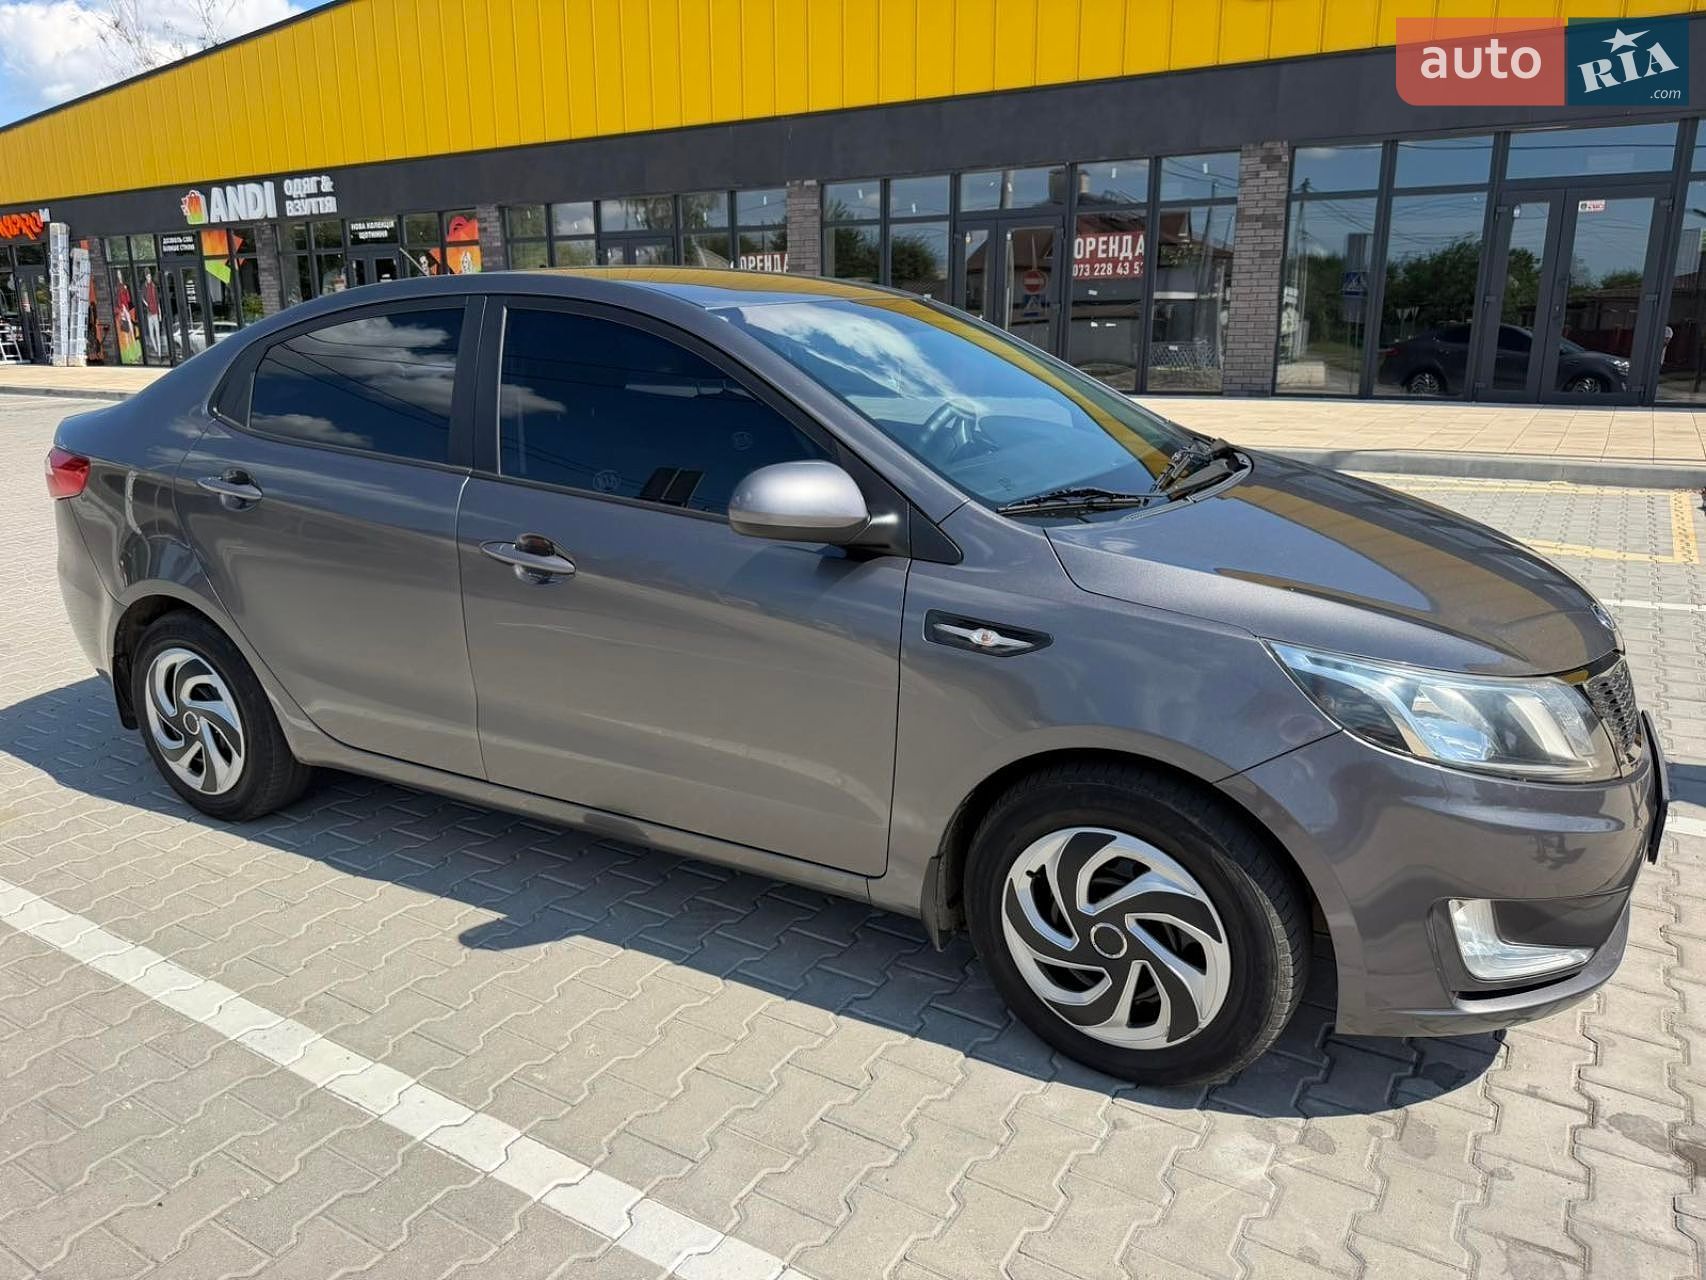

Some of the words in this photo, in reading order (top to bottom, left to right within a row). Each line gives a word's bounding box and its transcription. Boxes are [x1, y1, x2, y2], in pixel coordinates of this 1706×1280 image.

[210, 181, 278, 223] ANDI
[286, 196, 338, 217] ВЗУТТЯ
[1074, 234, 1145, 261] ОРЕНДА
[1072, 263, 1091, 277] 073
[1094, 262, 1113, 276] 228
[1116, 261, 1130, 275] 43
